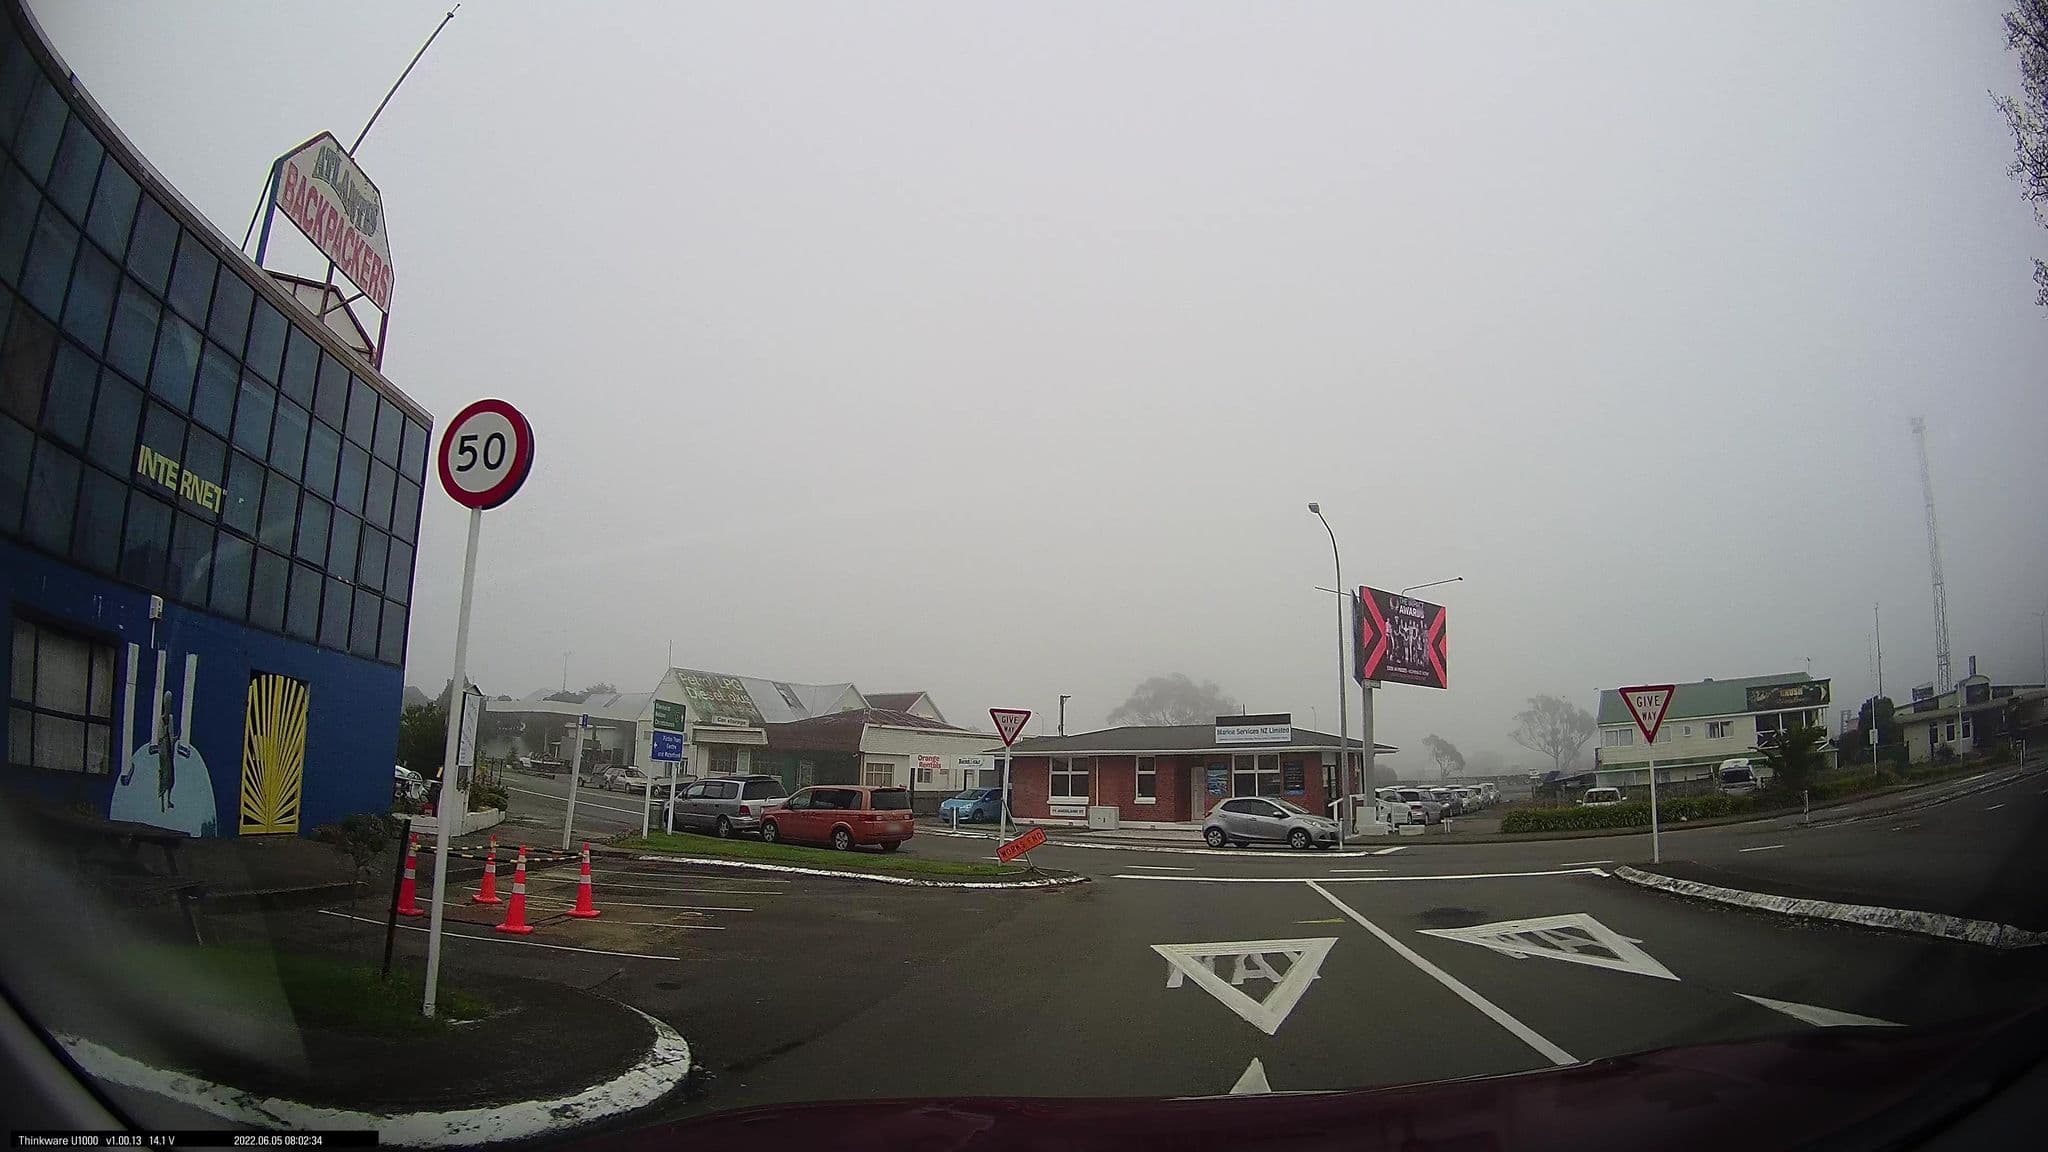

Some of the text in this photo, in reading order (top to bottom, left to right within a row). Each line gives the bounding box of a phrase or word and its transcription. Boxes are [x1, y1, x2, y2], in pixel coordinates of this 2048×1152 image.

[284, 161, 390, 308] BACKPACKERS
[456, 432, 506, 472] 50
[137, 444, 223, 514] INTERNET
[715, 676, 743, 690] LPG
[685, 686, 726, 701] Diesel
[1636, 695, 1661, 707] GIVE
[1001, 715, 1019, 724] GIVE
[1642, 711, 1657, 721] WAY
[917, 754, 940, 763] Orange
[919, 761, 942, 769] Rentals
[1001, 831, 1043, 858] WORKS END
